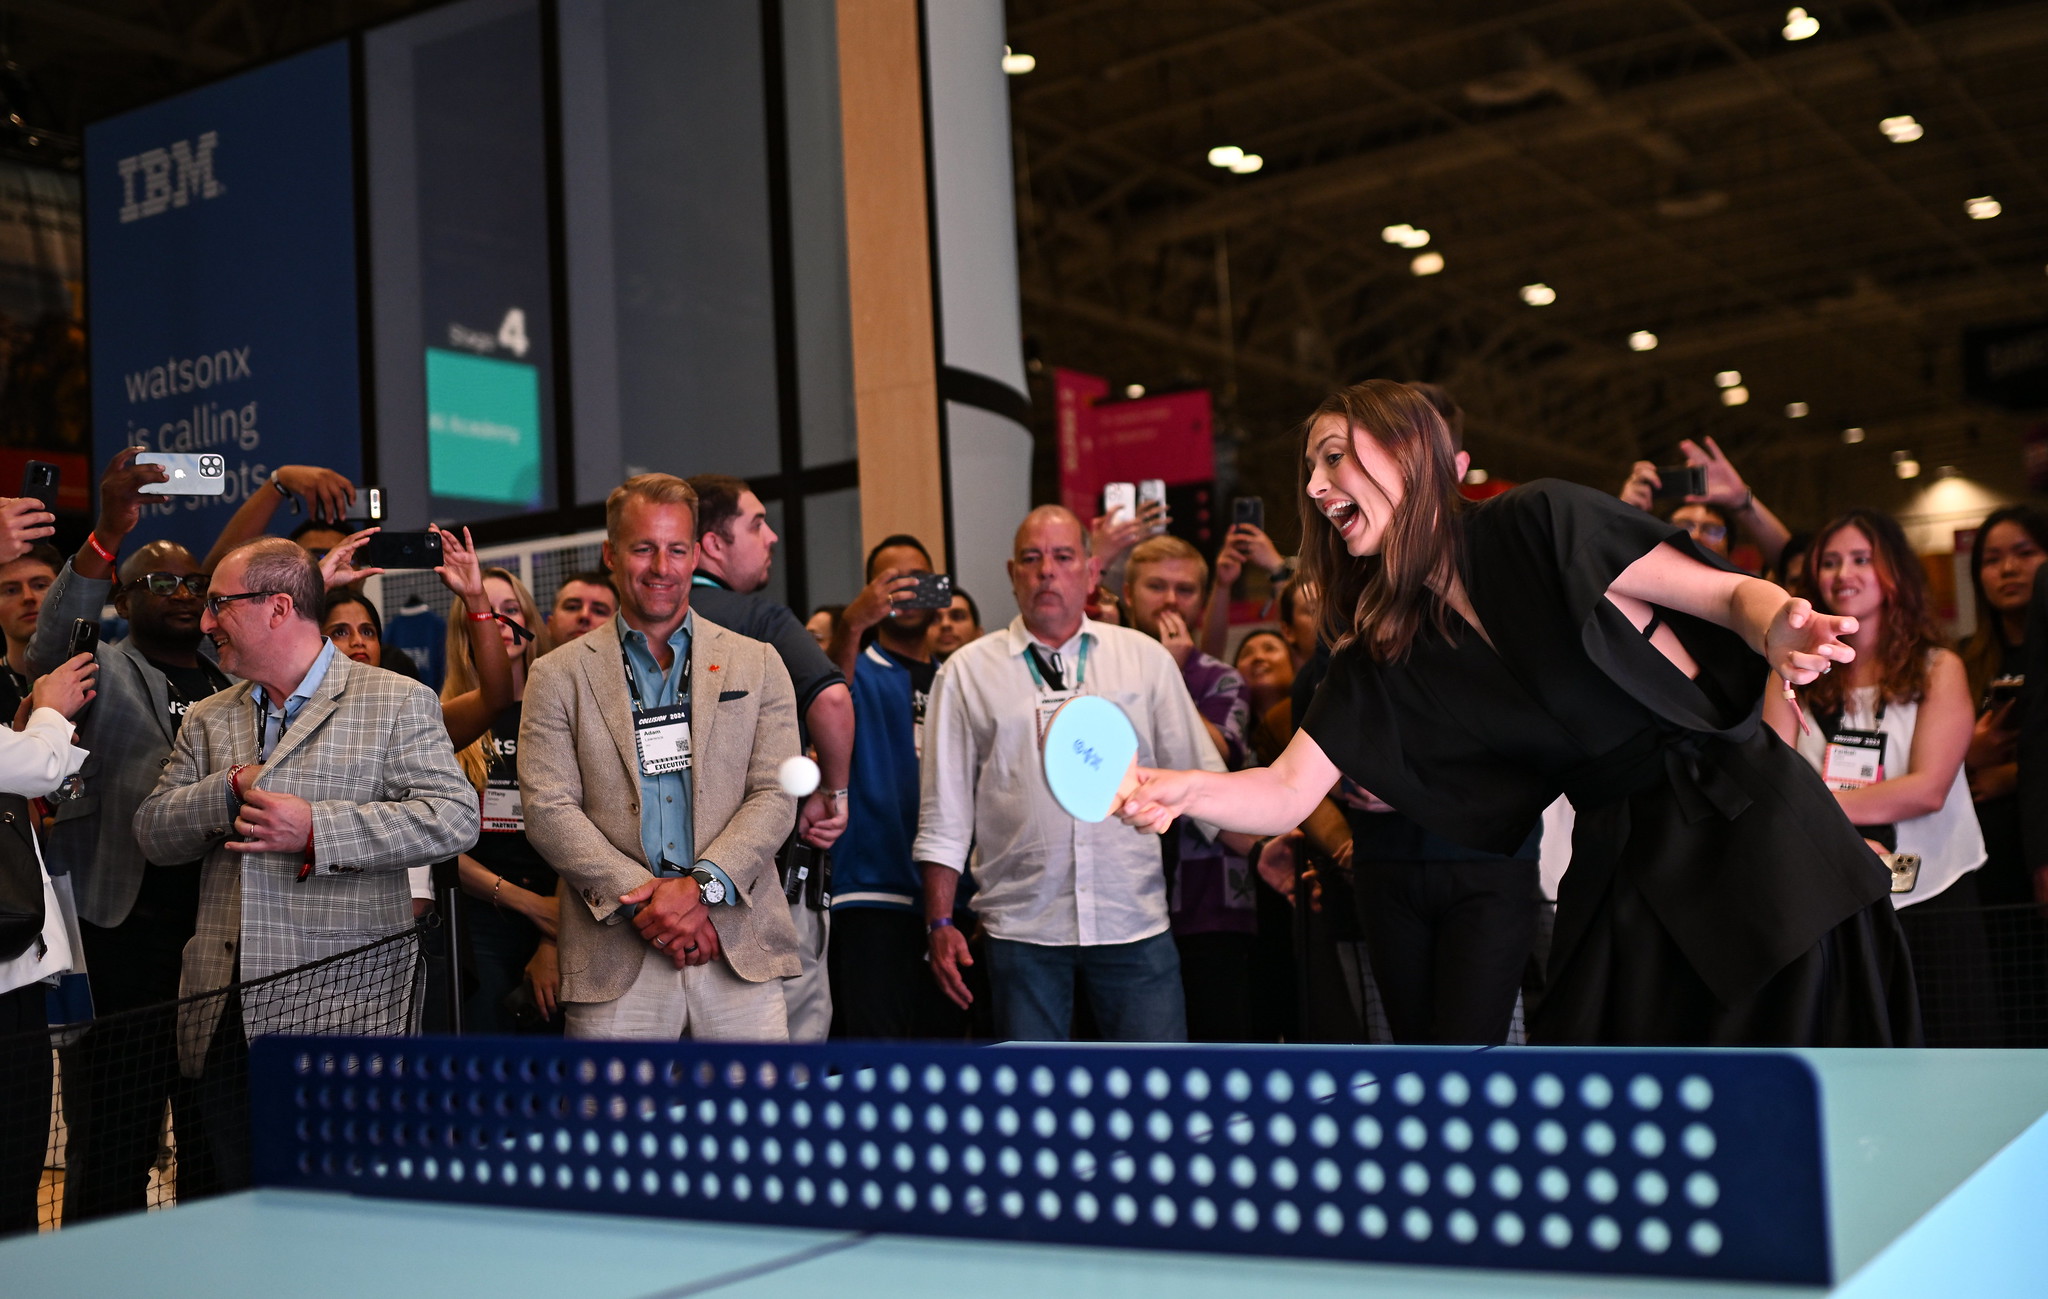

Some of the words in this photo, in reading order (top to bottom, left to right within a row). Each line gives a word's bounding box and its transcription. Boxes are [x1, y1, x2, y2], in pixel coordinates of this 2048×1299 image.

[118, 130, 218, 223] IBM
[498, 307, 530, 357] 4
[124, 345, 252, 403] watsonx
[127, 420, 150, 450] is
[157, 401, 260, 451] calling
[638, 714, 668, 726] COLLISION
[669, 711, 686, 721] 2024
[643, 729, 662, 737] Adam
[654, 759, 690, 771] EXECUTIVE
